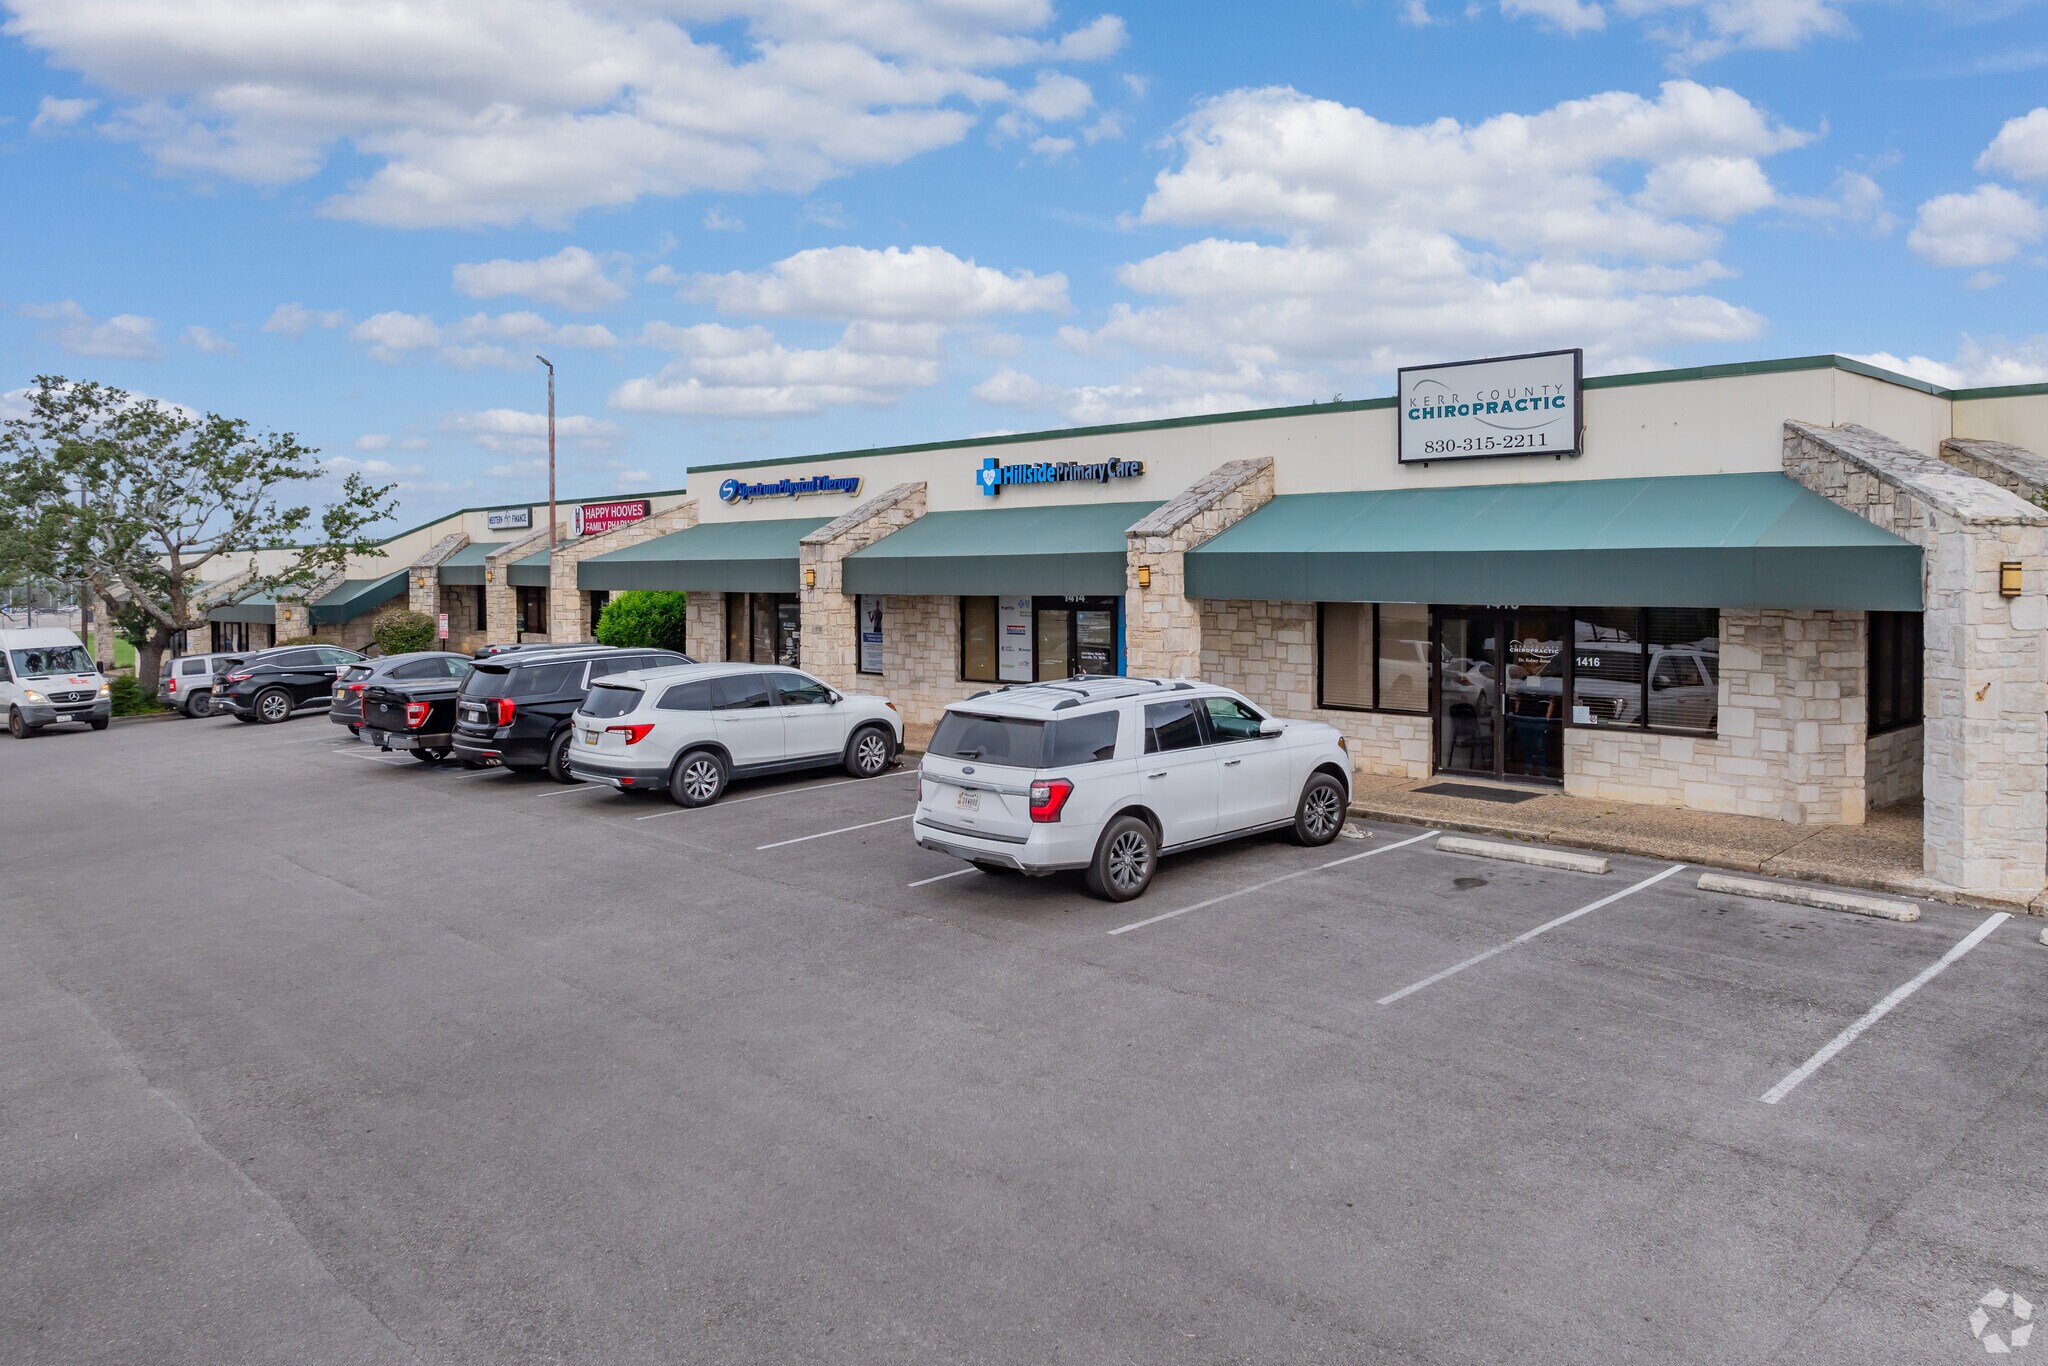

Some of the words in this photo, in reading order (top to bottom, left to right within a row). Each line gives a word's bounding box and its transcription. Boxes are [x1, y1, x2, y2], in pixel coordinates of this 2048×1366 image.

[1410, 393, 1460, 407] KERR
[1476, 384, 1563, 402] COUNTY
[1408, 395, 1566, 421] CHIROPRACTIC
[1424, 433, 1548, 454] 830-315-2211
[739, 482, 777, 500] Spectrum
[778, 477, 814, 497] Physical
[815, 475, 860, 494] Therapy
[511, 513, 527, 523] FINANCE
[585, 506, 610, 520] HAPPY
[611, 503, 643, 518] HOOVES
[585, 521, 607, 532] FAMILY
[1575, 657, 1601, 667] 1416
